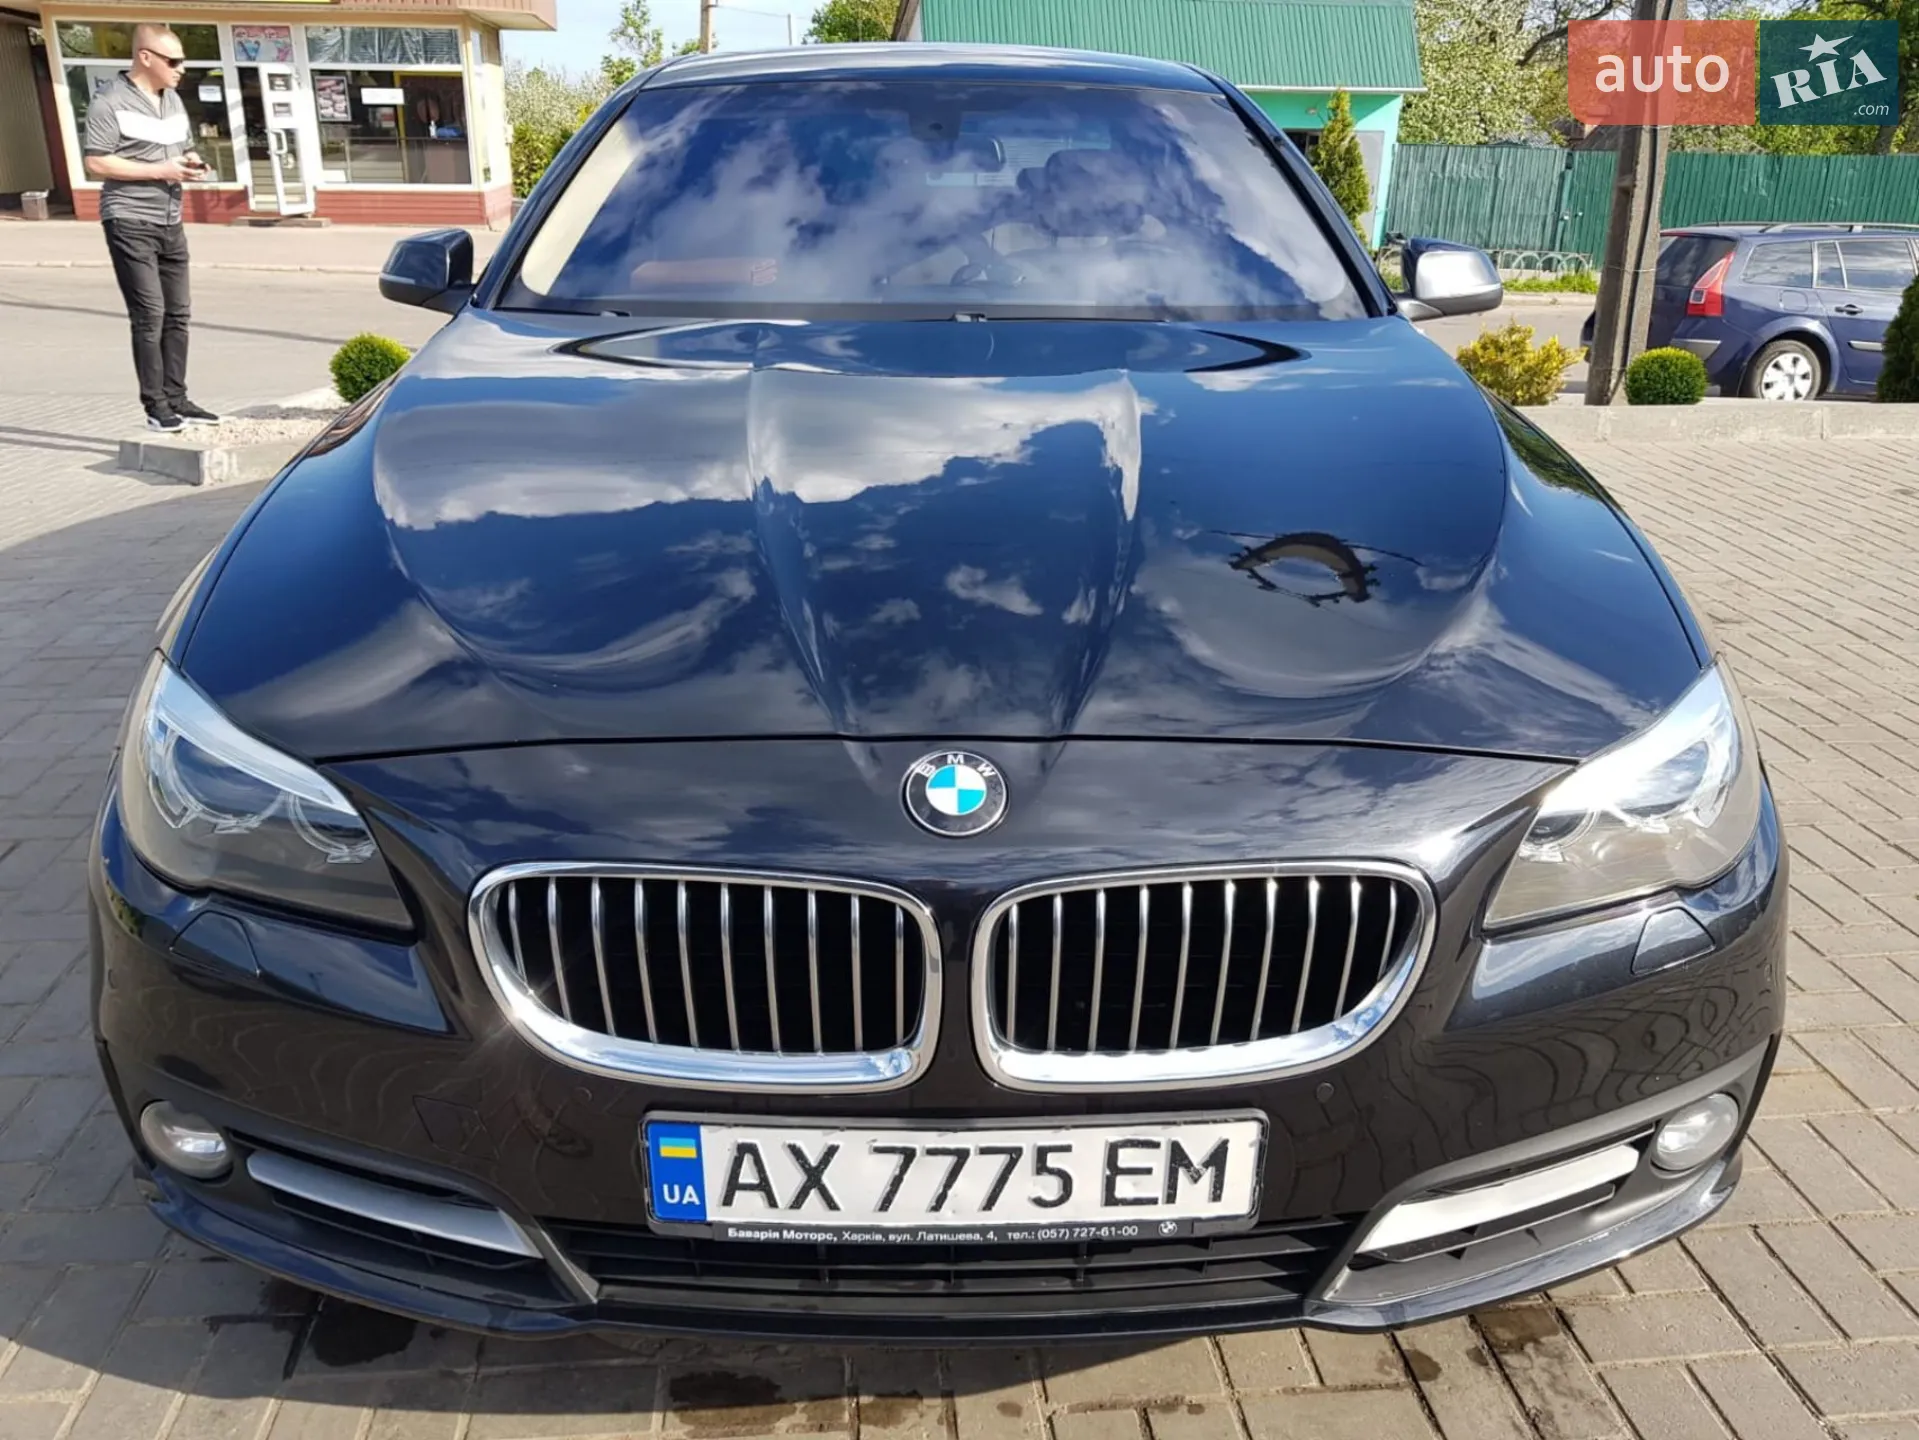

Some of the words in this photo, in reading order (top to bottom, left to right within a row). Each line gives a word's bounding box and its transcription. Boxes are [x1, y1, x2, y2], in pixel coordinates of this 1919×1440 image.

[917, 754, 996, 778] BMW
[720, 1141, 841, 1211] AX
[870, 1144, 1073, 1212] 7775
[1102, 1138, 1230, 1207] EM
[663, 1184, 700, 1205] UA
[728, 1227, 780, 1241] Баварія
[782, 1229, 837, 1242] Моторс,
[842, 1230, 886, 1243] Харків,
[888, 1233, 913, 1243] вул.
[916, 1230, 983, 1242] Латишева,
[986, 1230, 998, 1242] 4,
[1037, 1227, 1069, 1240] (057)
[1073, 1225, 1139, 1238] 727-61-00
